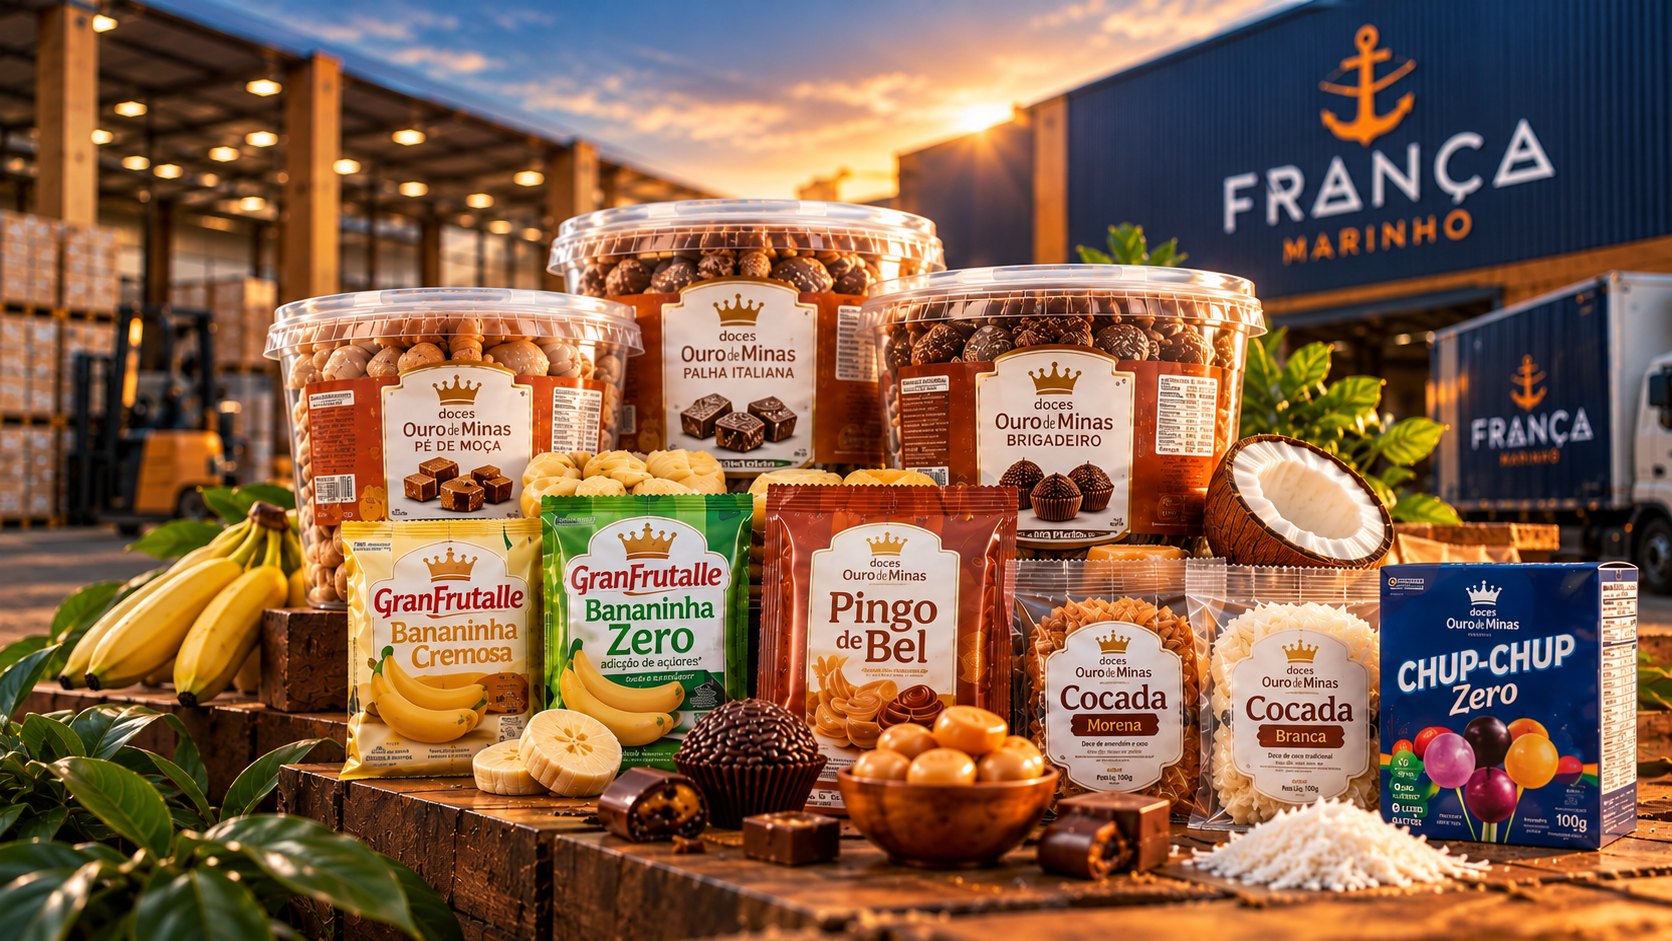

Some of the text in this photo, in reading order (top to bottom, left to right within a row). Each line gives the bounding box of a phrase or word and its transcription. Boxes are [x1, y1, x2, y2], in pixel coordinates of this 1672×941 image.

[1223, 118, 1555, 234] FRANÇA
[1282, 208, 1473, 266] MARINHO
[719, 330, 756, 342] doces
[681, 344, 796, 363] Ouro de Minas
[683, 366, 795, 379] PALHA ITALIANA
[1034, 398, 1073, 410] doces
[438, 408, 475, 420] doces
[995, 412, 1114, 431] Ouro de Minas
[403, 421, 512, 438] Ouro de Minas
[1471, 406, 1594, 450] FRANÇA
[415, 439, 502, 454] PÉ DE MOÇA
[1007, 433, 1102, 447] BRIGADEIRO
[870, 557, 901, 568] doces
[571, 562, 722, 595] GranFrutalle
[842, 569, 927, 581] Ouro de Minas
[374, 585, 524, 619] GranFrutalle
[585, 595, 715, 622] Bananinha
[828, 591, 938, 632] Pingo
[1469, 607, 1497, 617] doces
[391, 618, 518, 644] Bananinha
[1446, 617, 1520, 631] Ouro de Minas
[606, 623, 695, 656] Zero
[836, 629, 928, 663] de Bel
[412, 645, 513, 669] Cremosa
[642, 657, 655, 668] de
[1099, 656, 1127, 666] doces
[1397, 634, 1576, 695] CHUP-CHUP
[1075, 667, 1152, 678] Ouro de Minas
[1286, 665, 1314, 675] doces
[1262, 676, 1339, 689] Ouro de Minas
[1060, 684, 1168, 711] Cocada
[1449, 682, 1518, 717] Zero
[1246, 695, 1354, 722] Cocada
[1086, 719, 1142, 733] Morena
[1276, 729, 1327, 743] Branca
[1556, 813, 1588, 833] 100g
